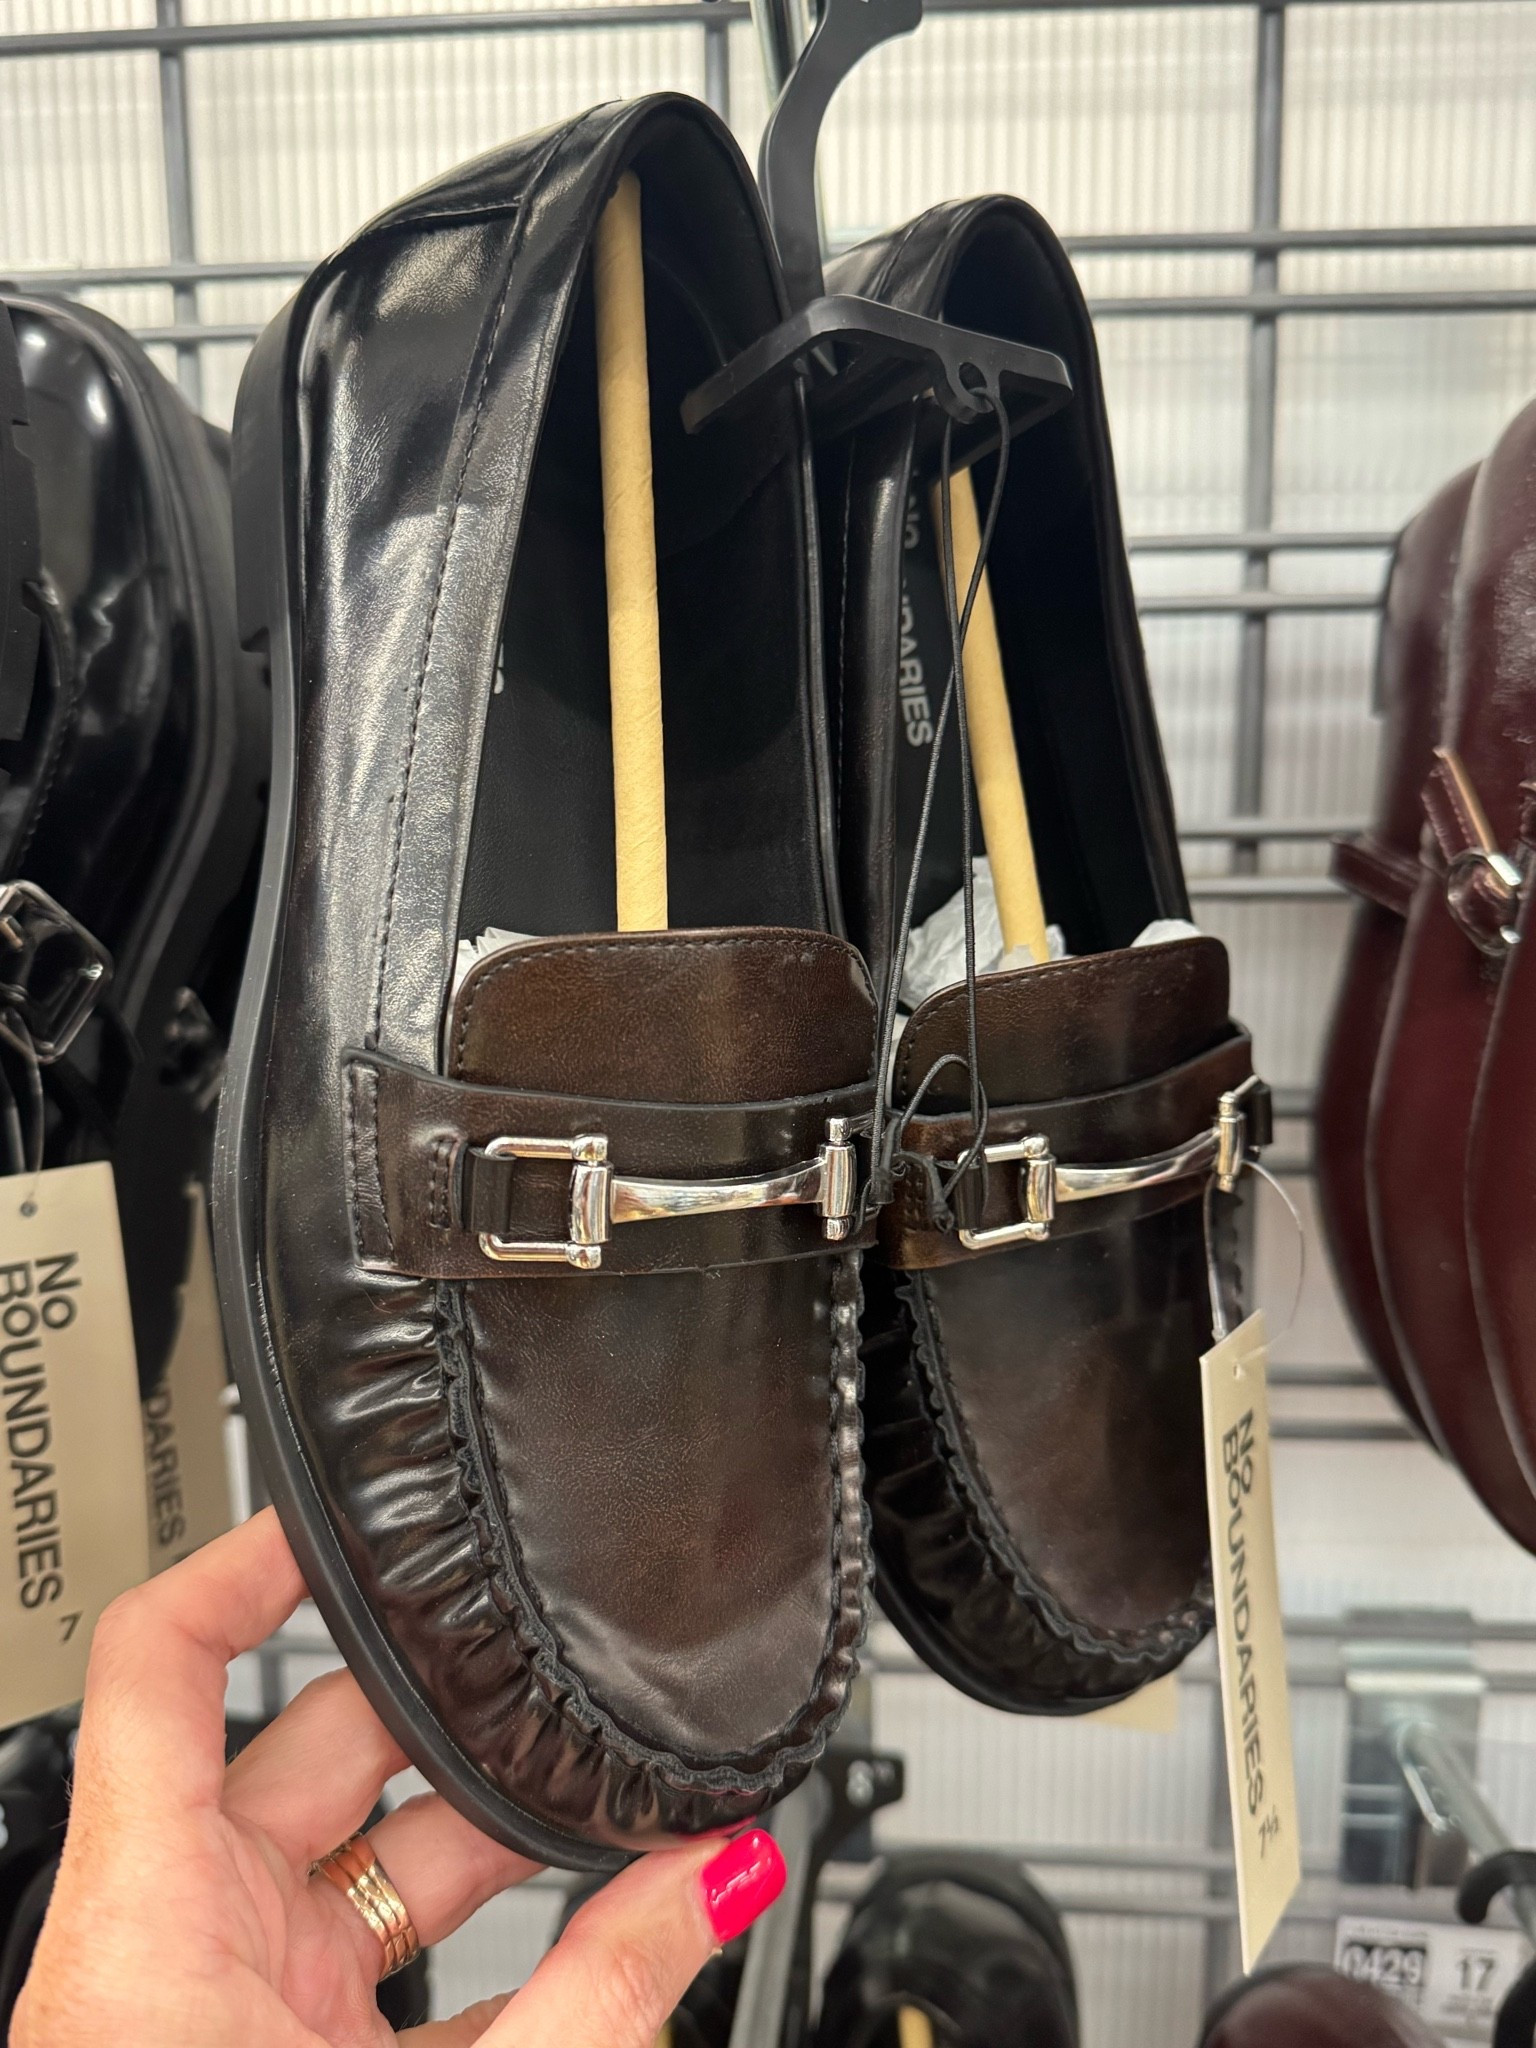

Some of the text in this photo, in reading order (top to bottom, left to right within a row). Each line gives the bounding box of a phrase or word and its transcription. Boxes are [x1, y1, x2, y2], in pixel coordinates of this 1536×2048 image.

[146, 1383, 186, 1546] DARIES
[59, 1610, 84, 1644] 7
[1222, 1424, 1264, 1816] BOUNDARIES
[1460, 1955, 1495, 1990] 17
